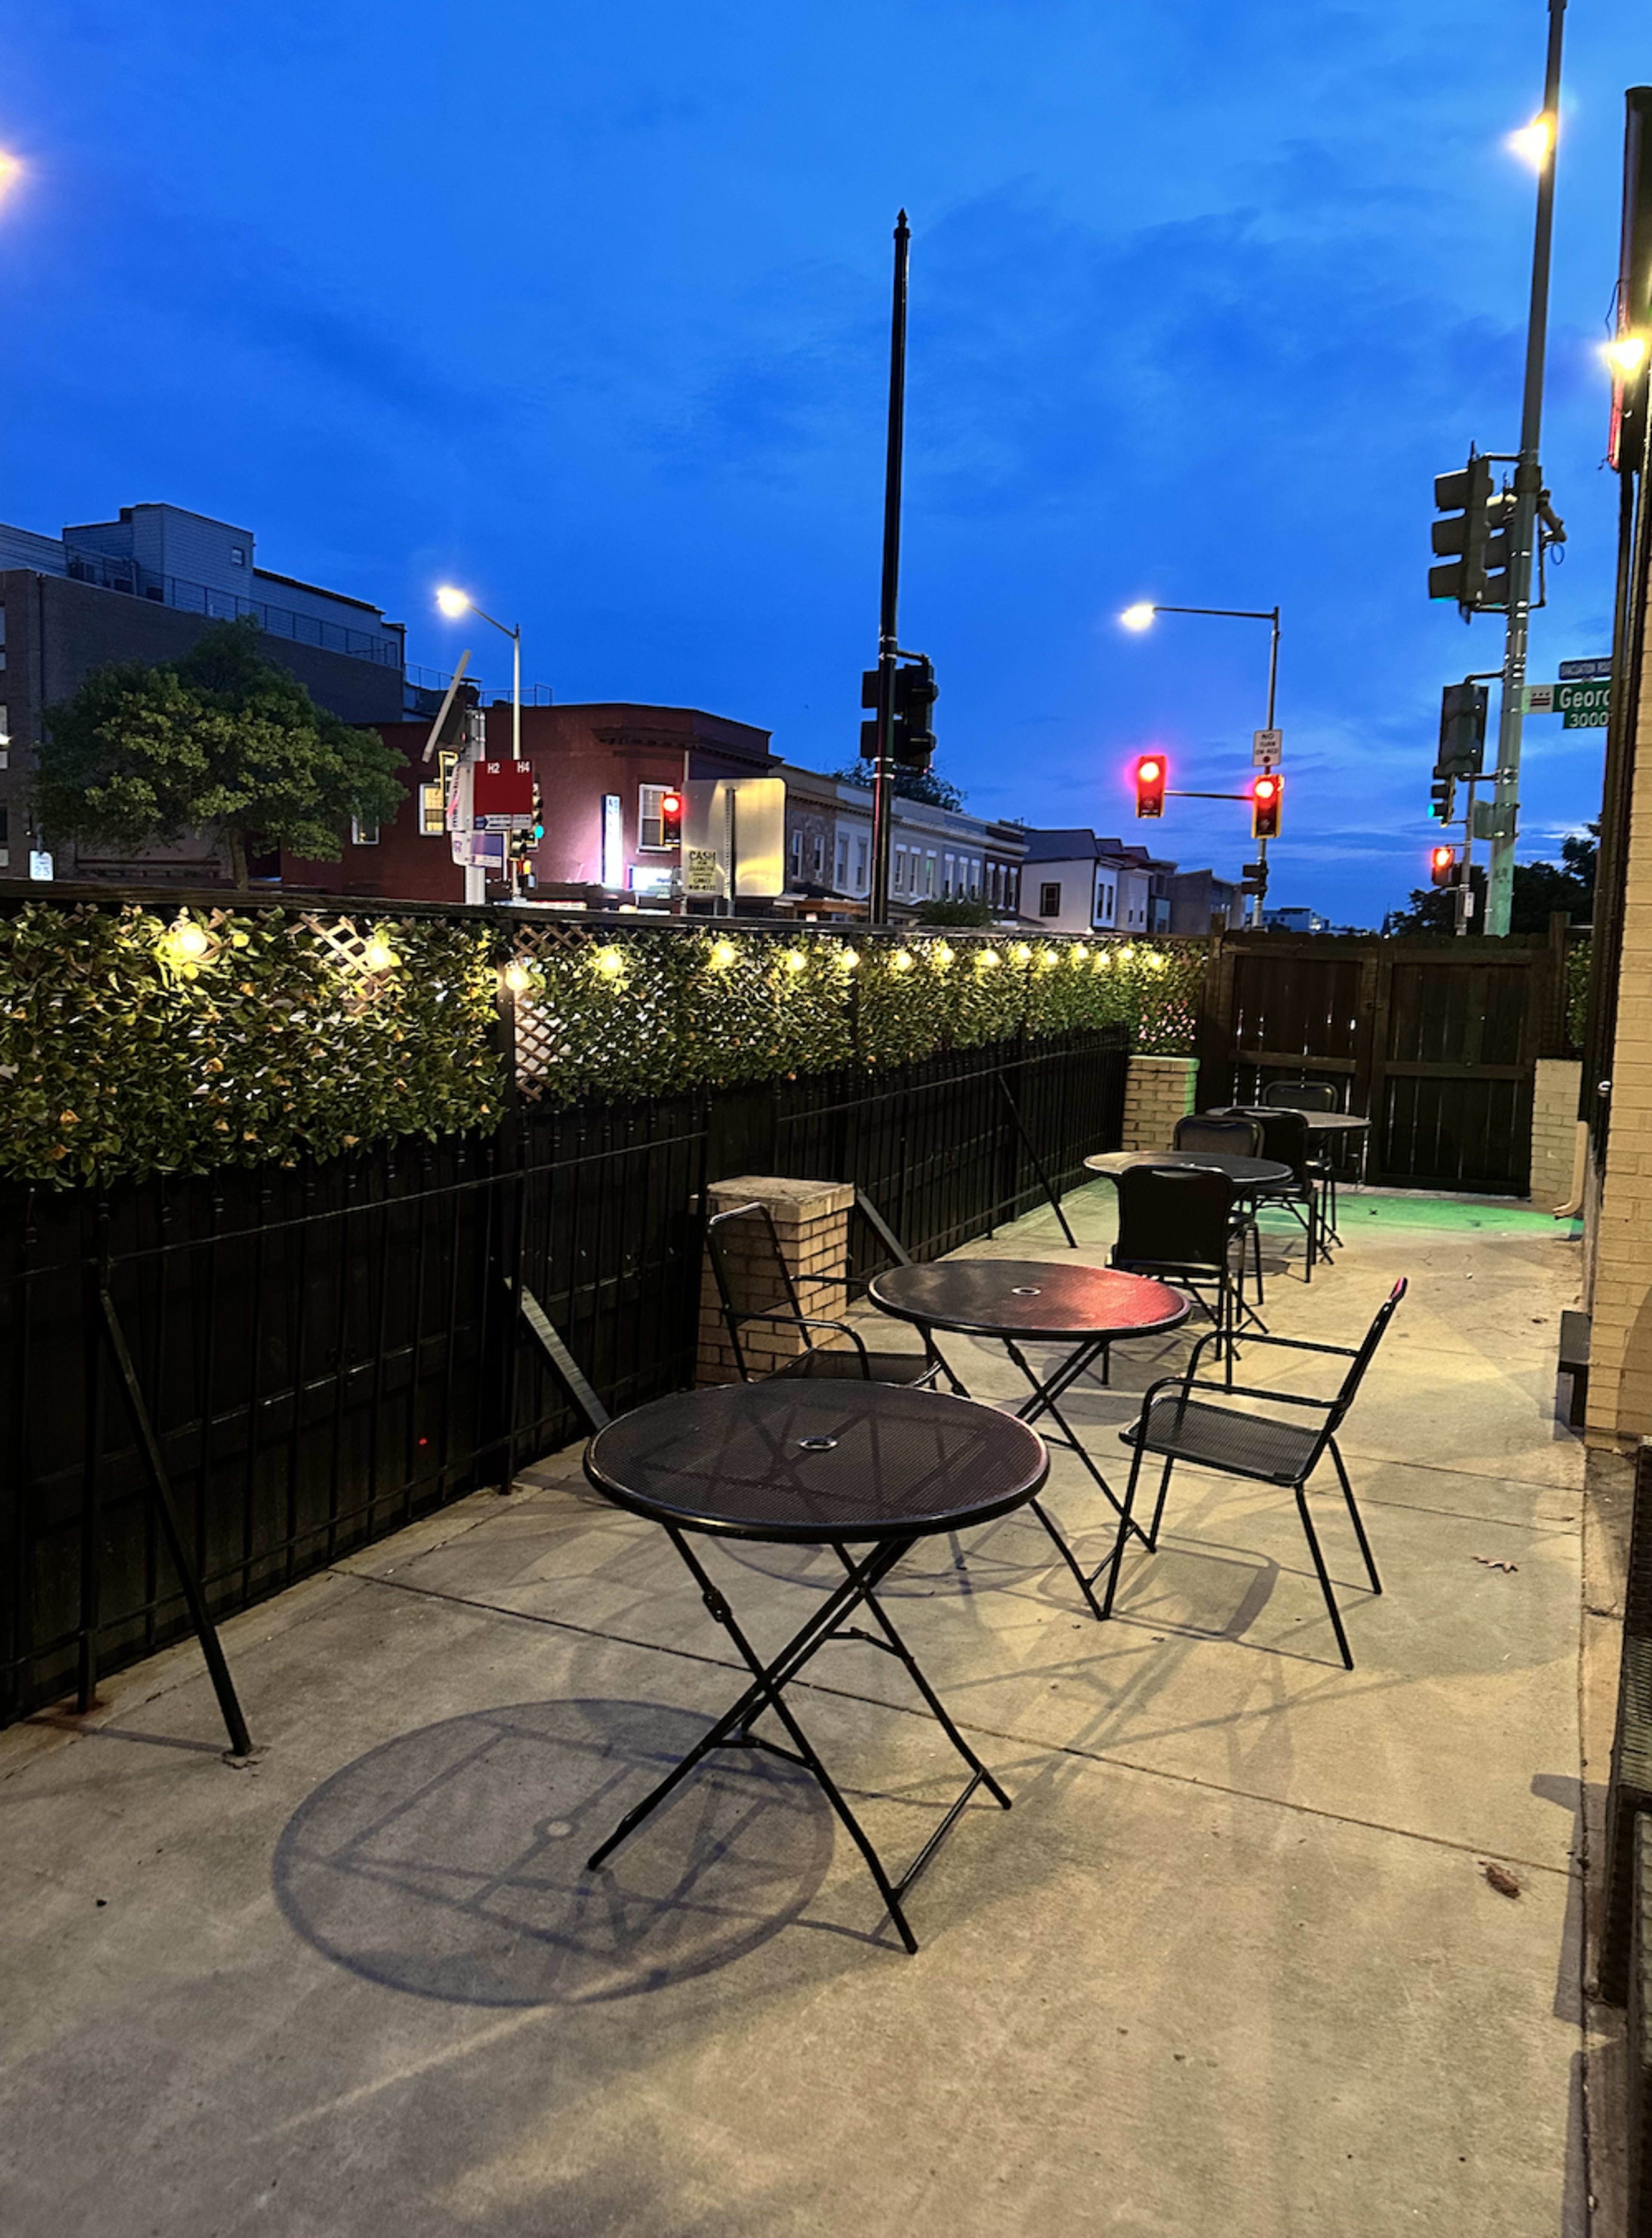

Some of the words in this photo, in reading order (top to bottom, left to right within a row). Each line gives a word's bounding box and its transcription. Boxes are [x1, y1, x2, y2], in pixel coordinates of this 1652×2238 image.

[1569, 712, 1609, 728] 3000
[487, 762, 500, 774] H2
[517, 761, 530, 773] H4
[689, 851, 716, 860] CASH
